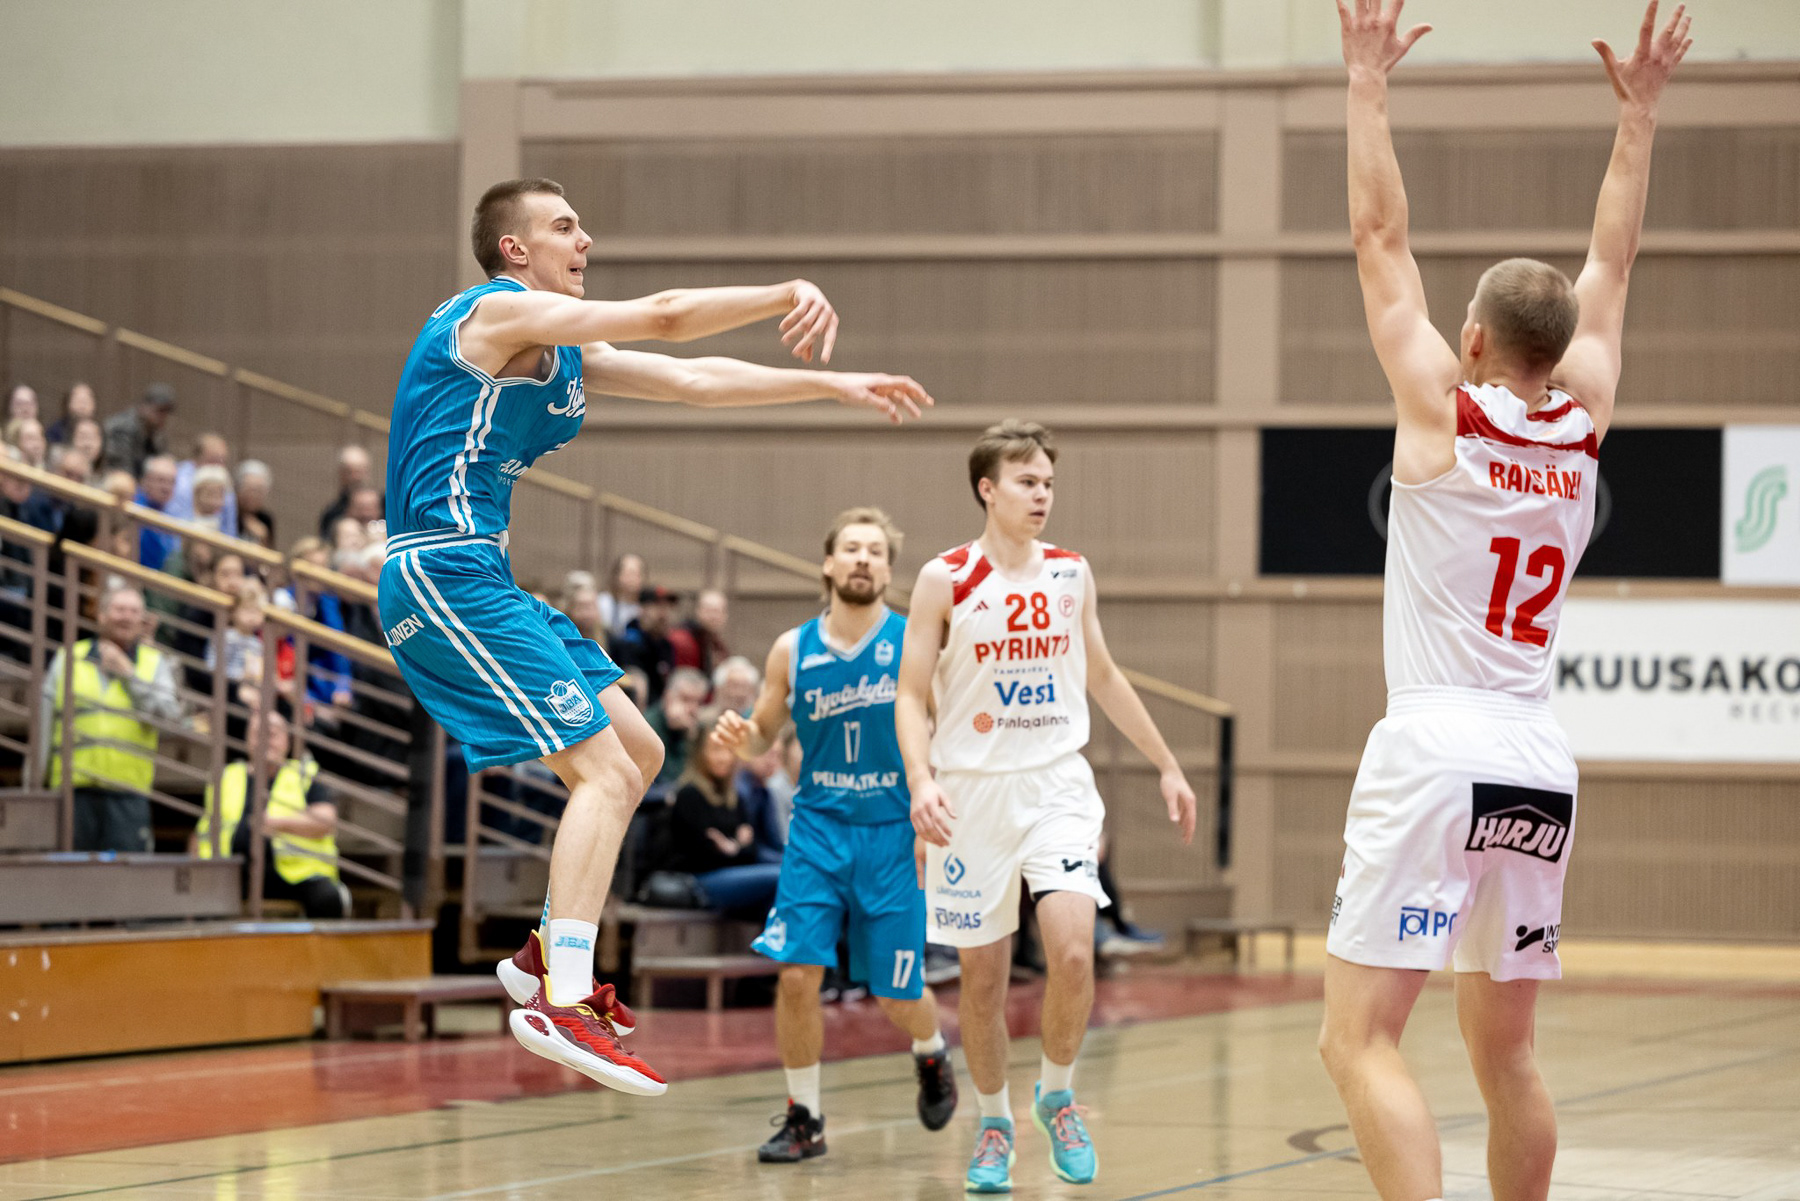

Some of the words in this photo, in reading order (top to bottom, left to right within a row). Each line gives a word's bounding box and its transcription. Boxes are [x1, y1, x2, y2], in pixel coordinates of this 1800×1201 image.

[1489, 459, 1582, 501] RÄISÄN
[1005, 592, 1050, 632] 28
[1485, 537, 1566, 647] 12
[994, 673, 1055, 706] Vesi
[1558, 656, 1800, 692] KUUSAKO
[843, 721, 861, 763] 17
[1470, 817, 1567, 858] HARJU
[554, 935, 591, 951] JBA
[892, 949, 915, 989] 17
